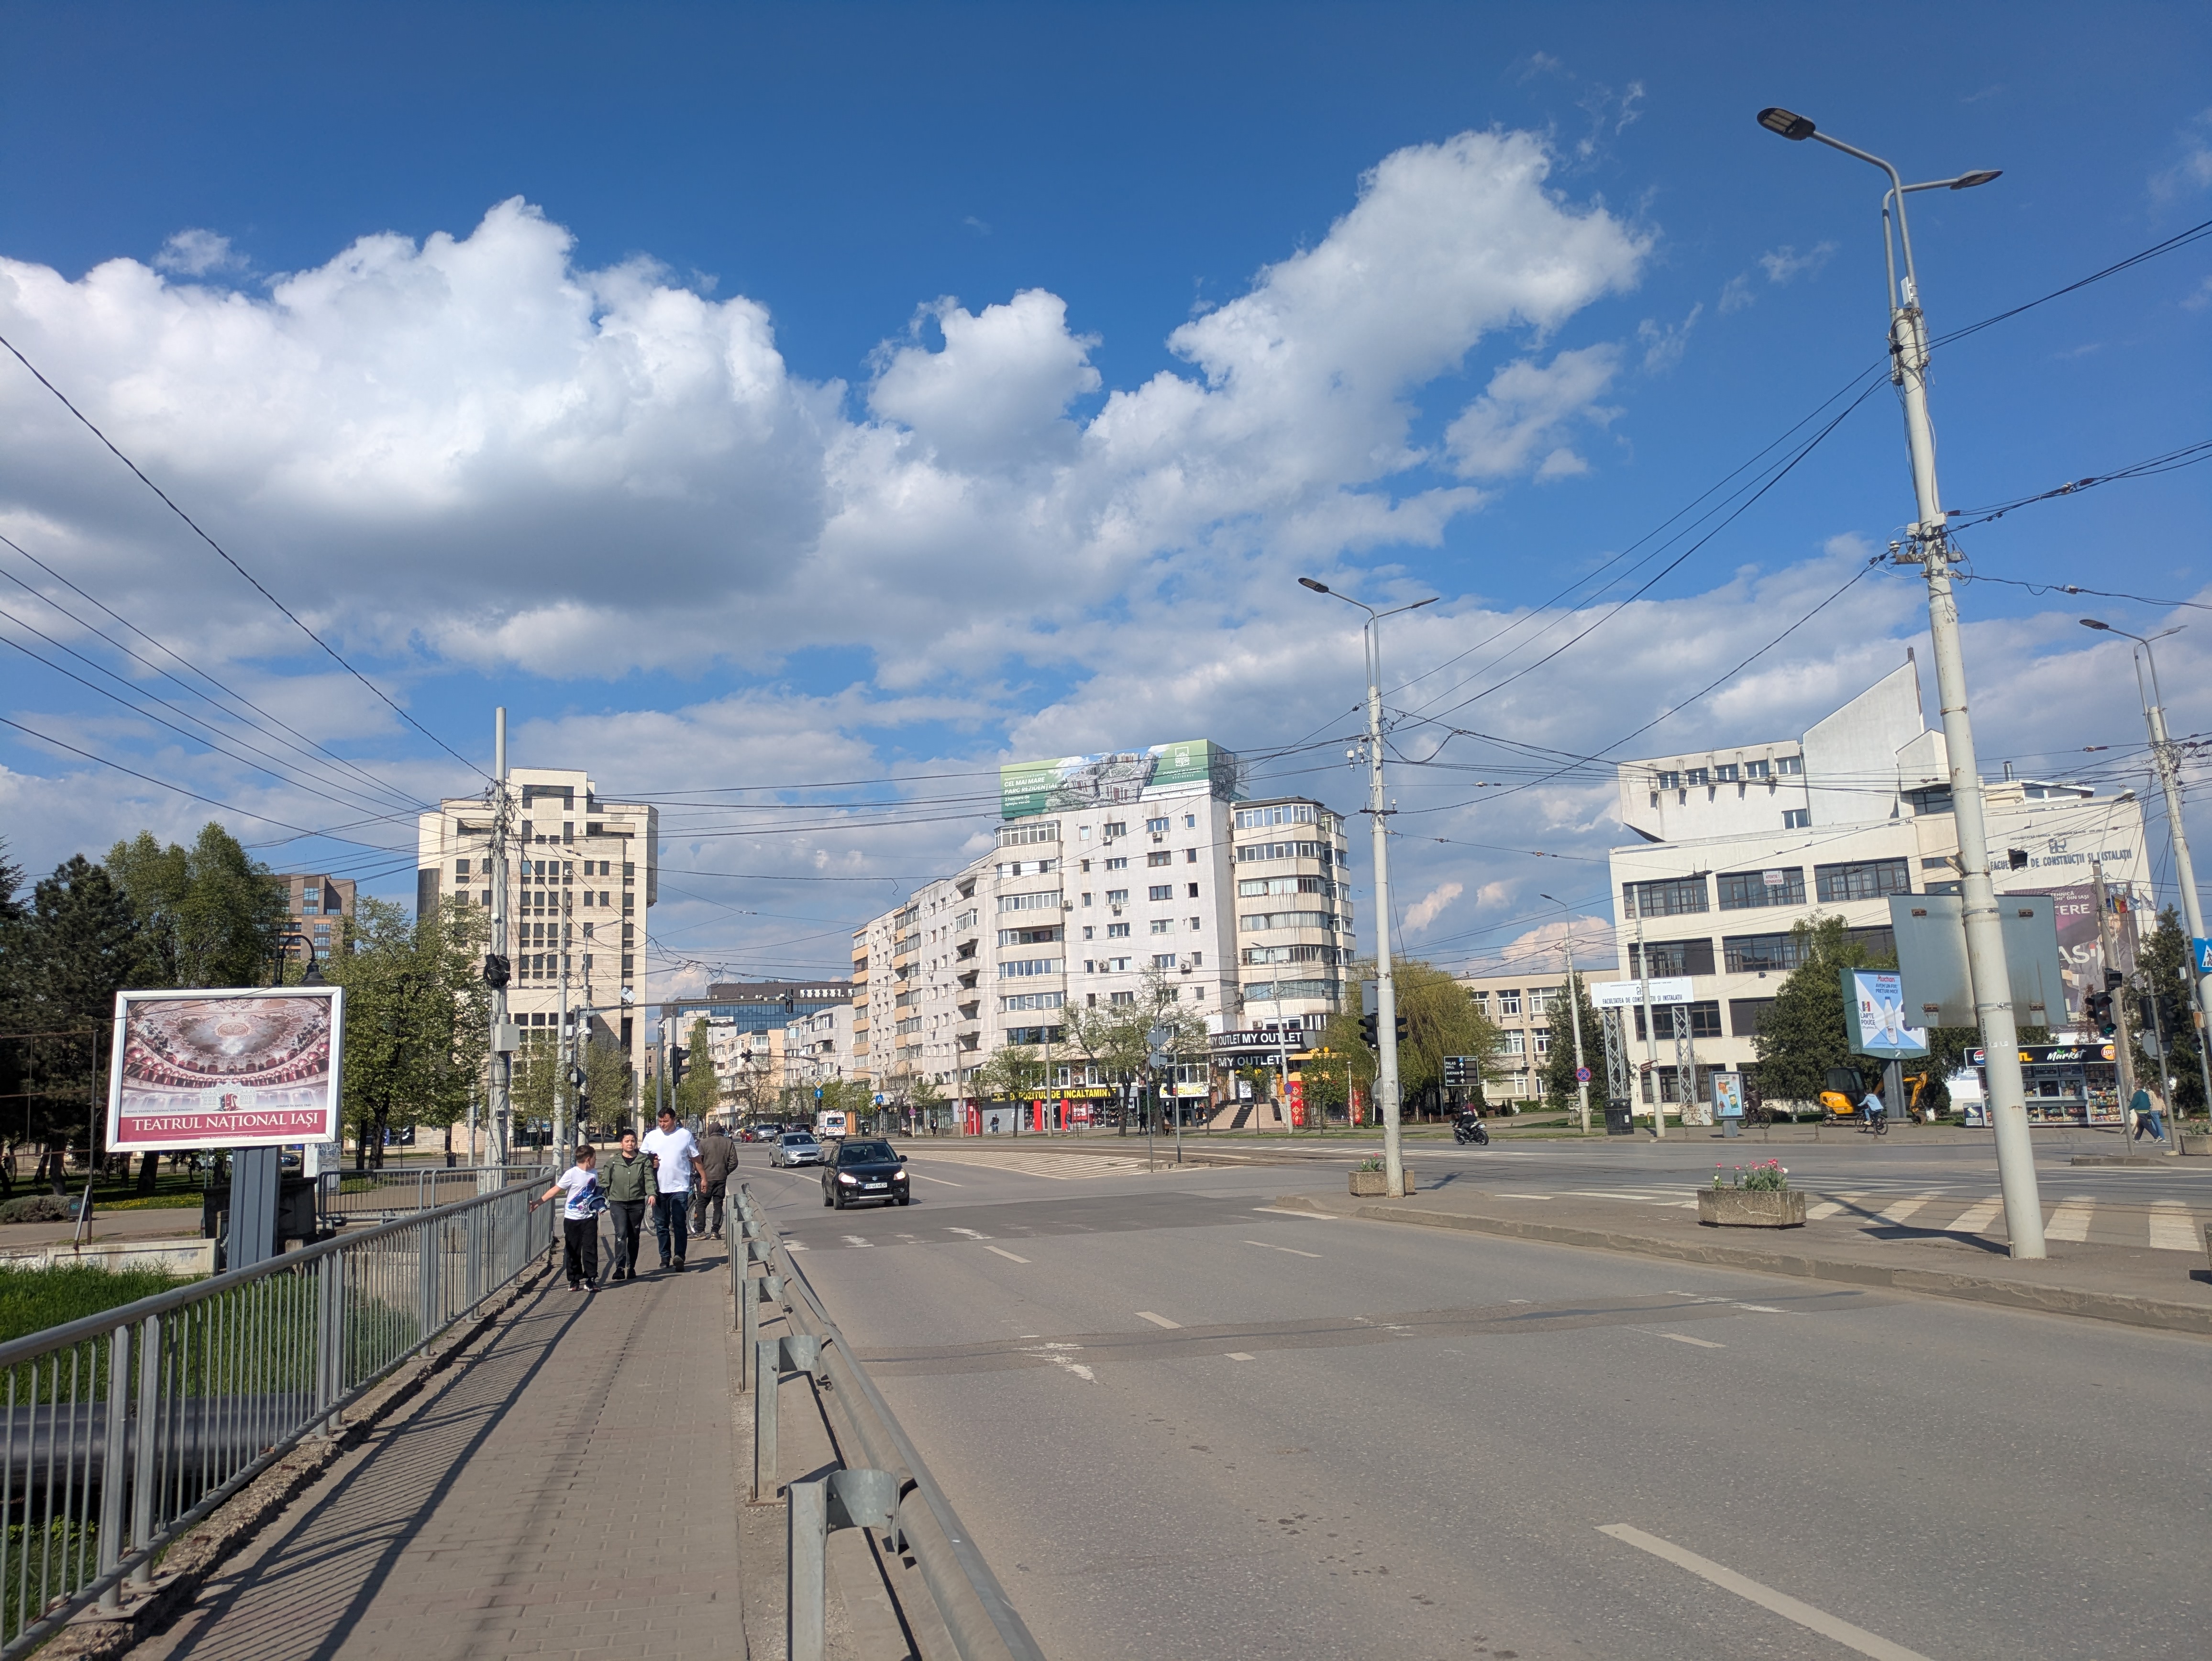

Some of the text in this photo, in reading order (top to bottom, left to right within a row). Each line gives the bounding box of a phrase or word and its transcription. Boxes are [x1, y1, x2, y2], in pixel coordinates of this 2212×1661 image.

[2031, 858, 2039, 867] DE
[1209, 1037, 1217, 1046] MY
[1218, 1034, 1240, 1045] OUTLET
[1242, 1033, 1258, 1043] MY
[1218, 1055, 1281, 1067] MY OUTLET
[2046, 1049, 2086, 1061] Market
[1051, 1090, 1061, 1099] DE
[132, 1117, 202, 1131] TEATRUL
